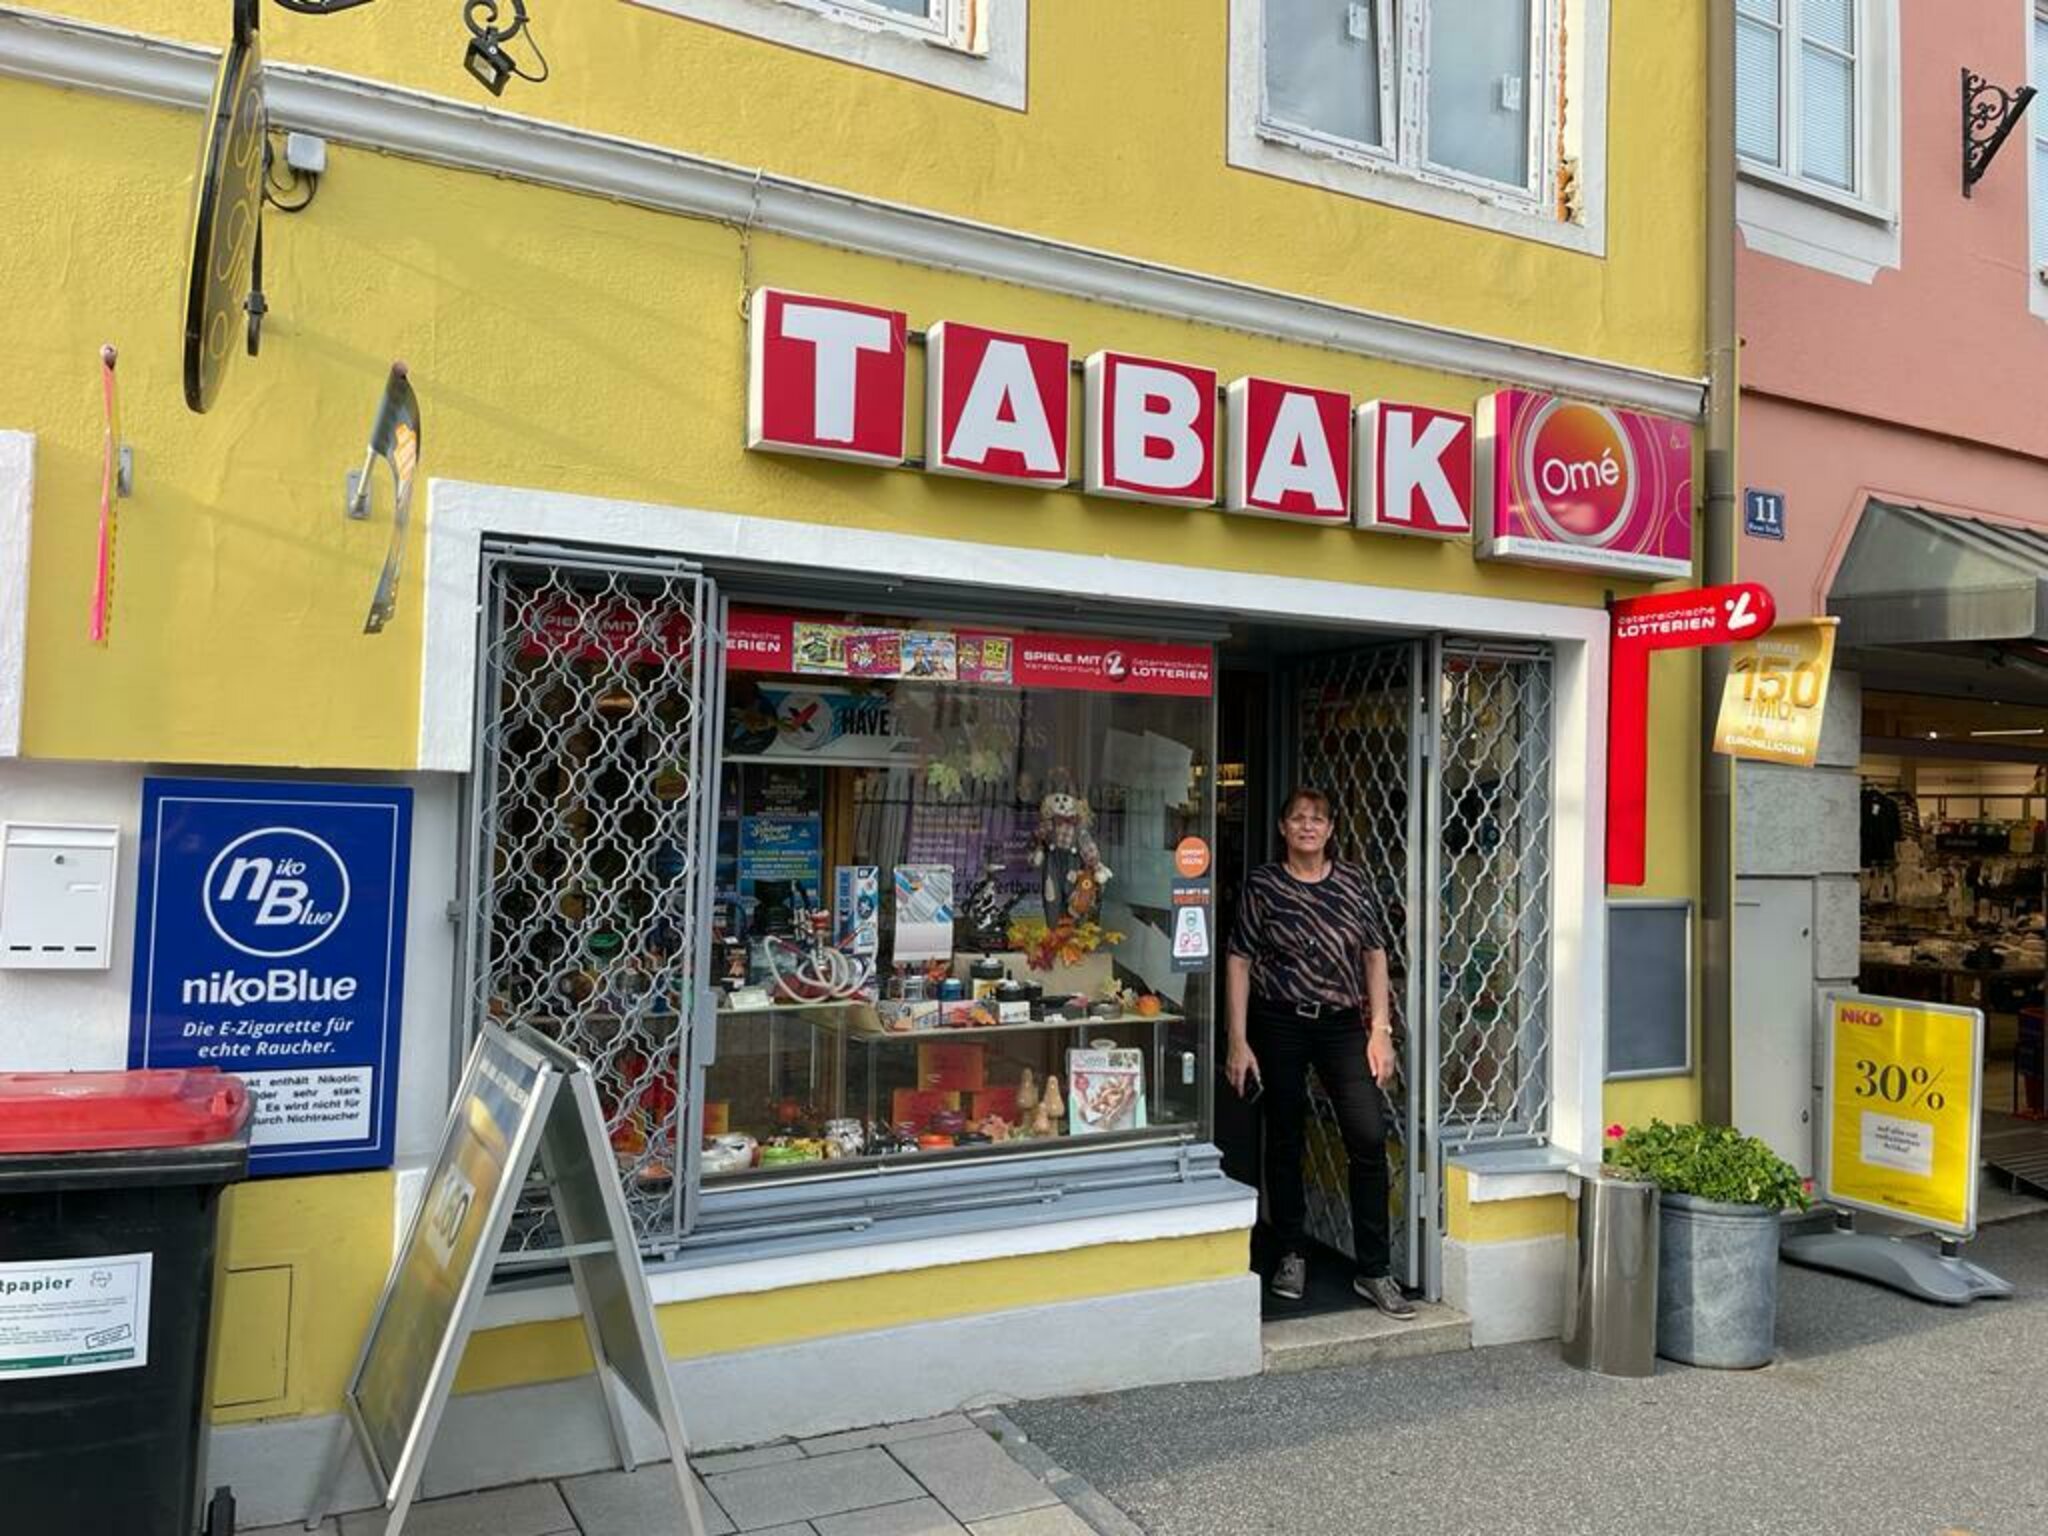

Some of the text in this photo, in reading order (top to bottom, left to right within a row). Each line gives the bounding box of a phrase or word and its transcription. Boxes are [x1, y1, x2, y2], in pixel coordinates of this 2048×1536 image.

[782, 303, 1469, 527] TABAK
[1541, 447, 1620, 495] Omé
[1755, 496, 1777, 524] 11
[1617, 617, 1716, 638] LOTTERIEN
[726, 638, 781, 652] ERIEN
[1023, 651, 1101, 665] SPIELE MIT
[1131, 666, 1209, 681] LOTTERIEN
[1734, 654, 1822, 709] 150
[182, 969, 358, 1007] nikoBlue
[1840, 1007, 1883, 1027] NKD
[183, 1017, 355, 1038] Die E-Zigarette für
[198, 1039, 336, 1058] echte Raucher.
[269, 1075, 309, 1087] enthält
[1855, 1059, 1945, 1110] 30%
[293, 1089, 318, 1098] sehr
[333, 1087, 360, 1096] stark
[265, 1098, 360, 1112] Es wird nicht für
[287, 1112, 360, 1123] Nichtraucher
